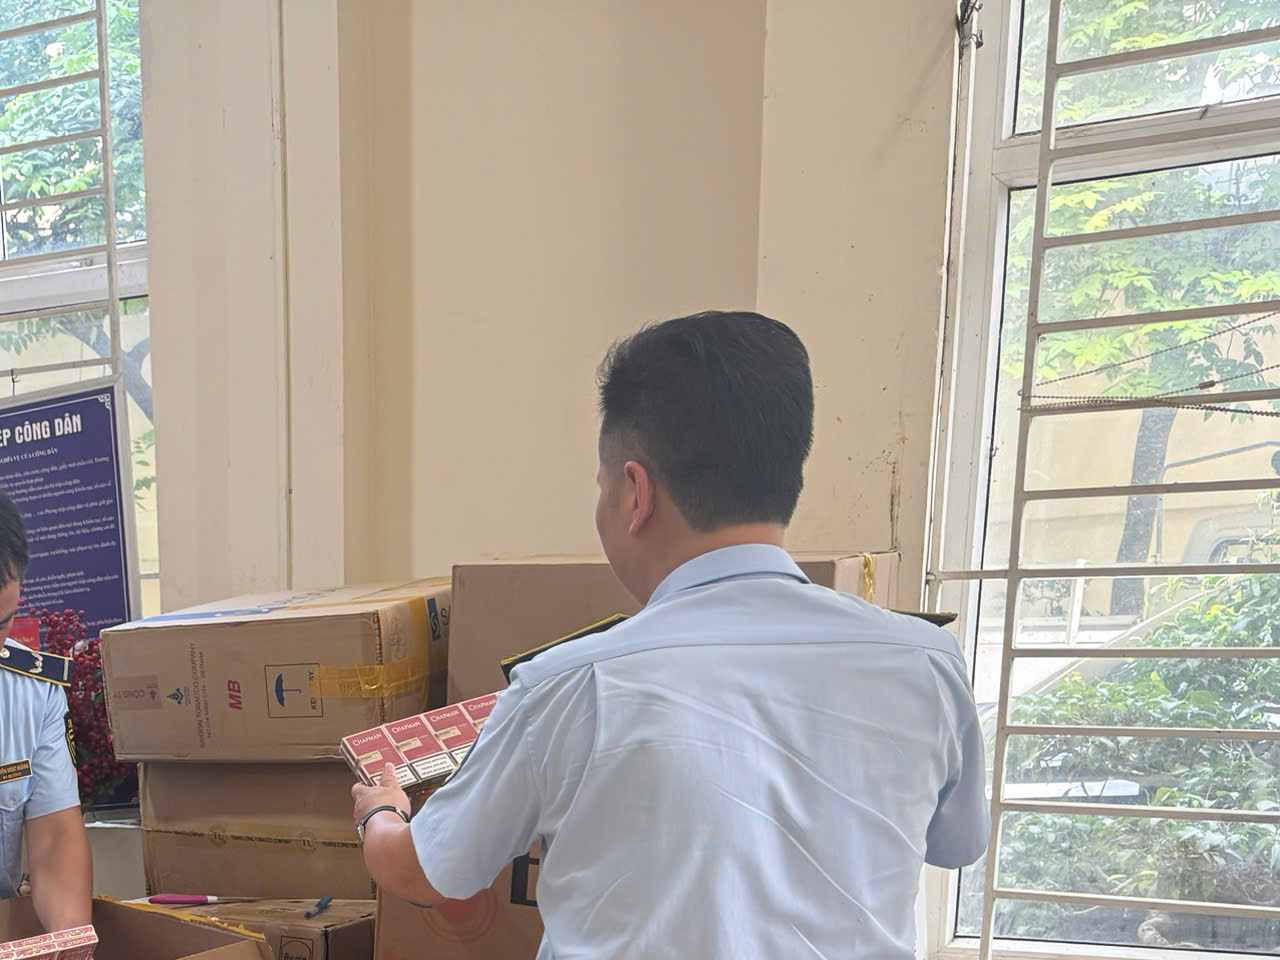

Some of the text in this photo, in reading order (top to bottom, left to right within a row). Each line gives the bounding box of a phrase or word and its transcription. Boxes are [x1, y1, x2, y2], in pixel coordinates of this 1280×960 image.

[14, 419, 51, 445] CÔNG
[54, 413, 82, 436] DÂN
[228, 679, 243, 710] MB
[430, 709, 459, 723] CHAPMAN
[391, 720, 421, 734] CHAPMAN
[352, 732, 382, 747] CHAPMAN
